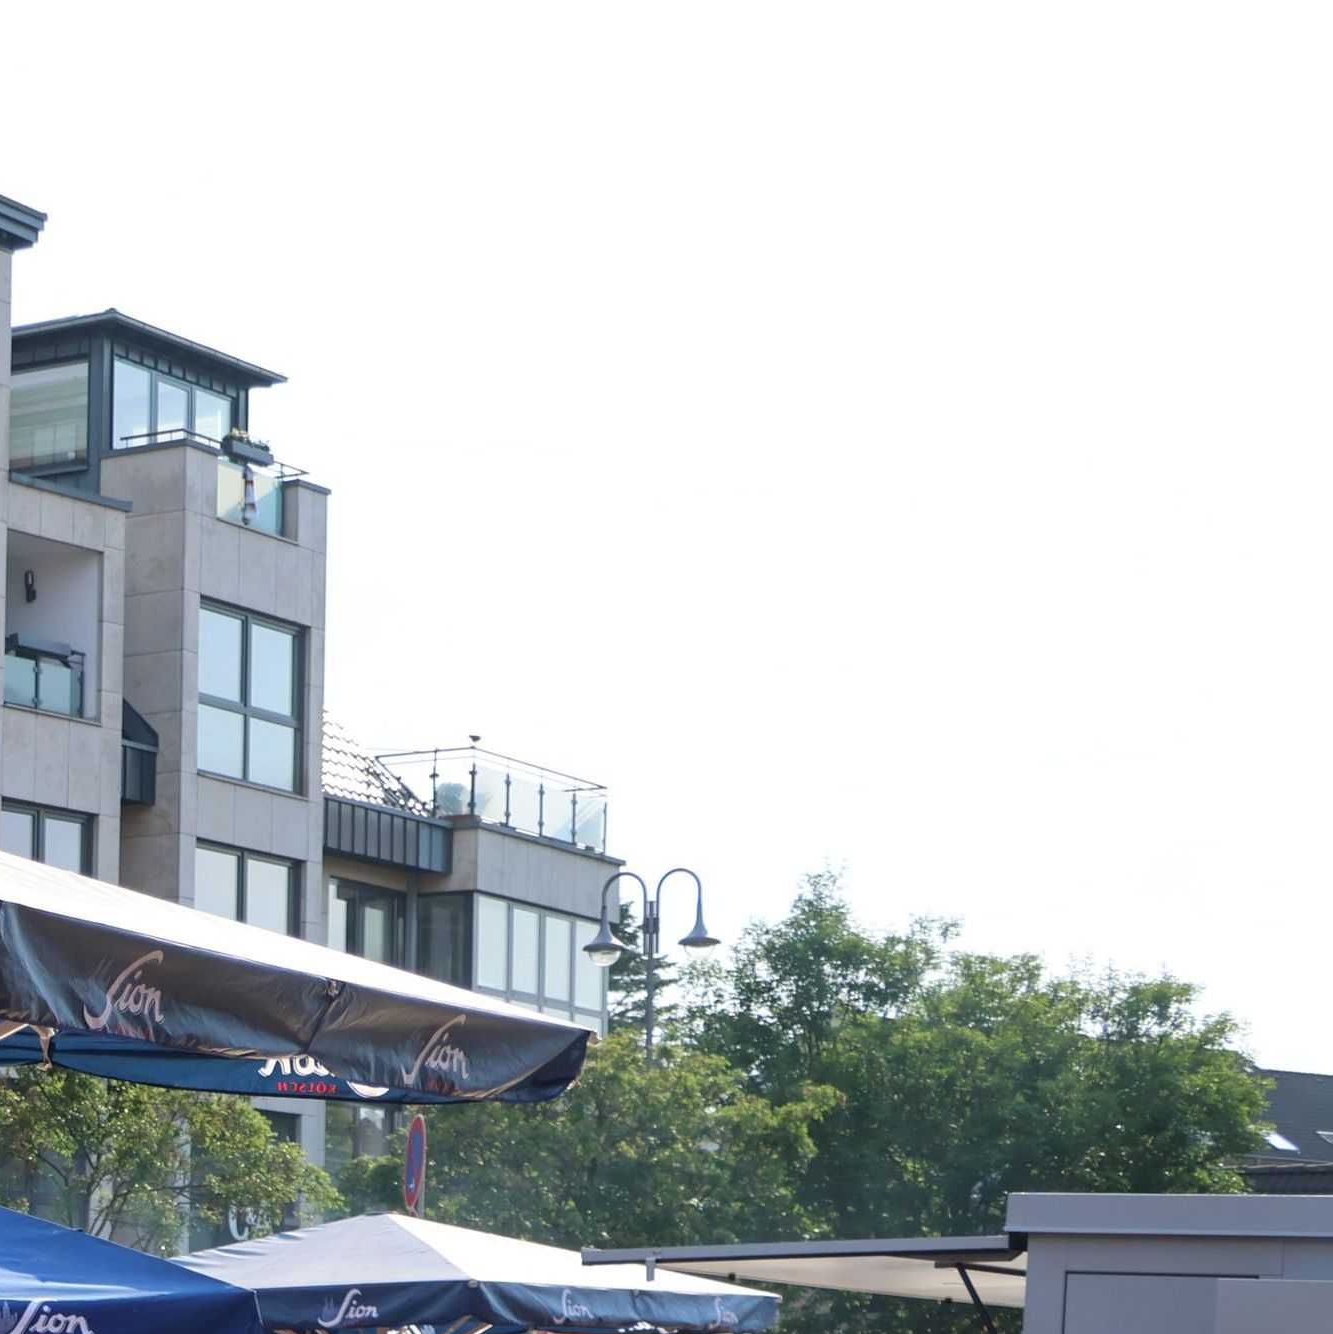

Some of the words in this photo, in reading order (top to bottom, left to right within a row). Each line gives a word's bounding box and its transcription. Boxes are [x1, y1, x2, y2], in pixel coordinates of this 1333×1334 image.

[84, 949, 164, 1031] Sion
[401, 1014, 470, 1086] Sion
[317, 1288, 380, 1328] Sion
